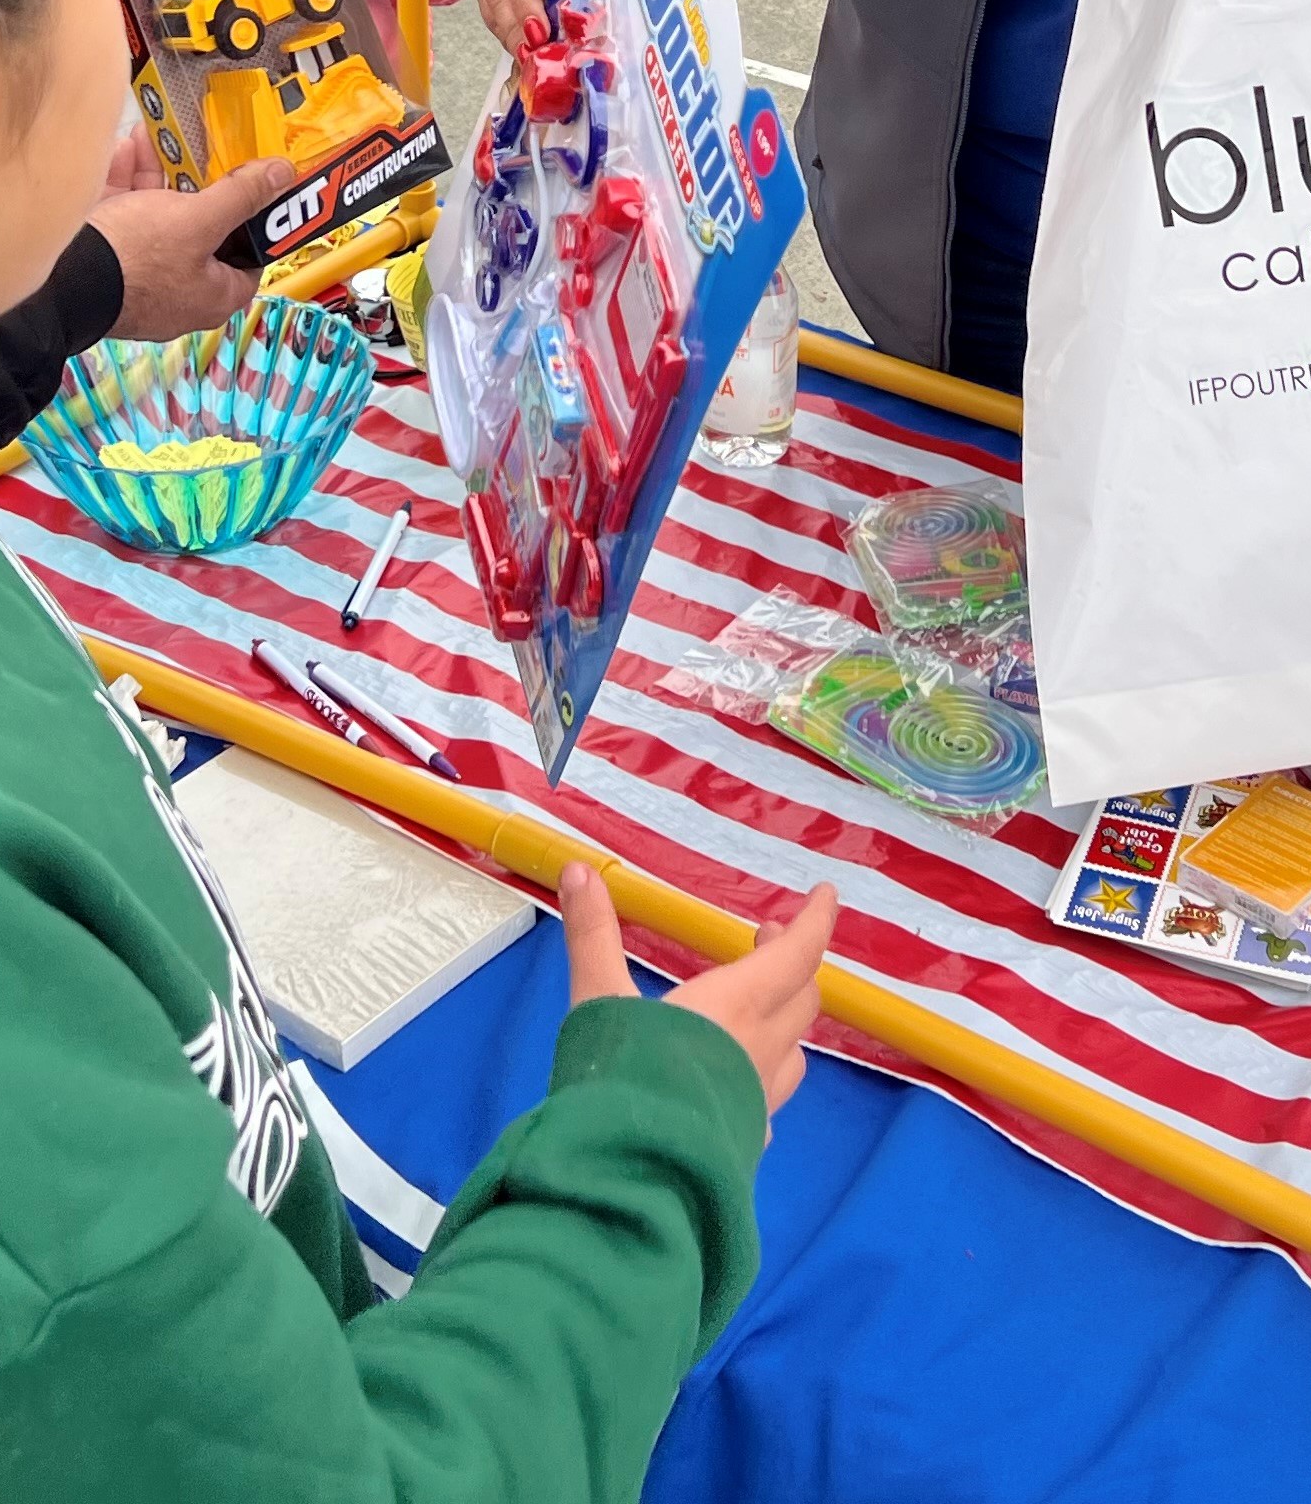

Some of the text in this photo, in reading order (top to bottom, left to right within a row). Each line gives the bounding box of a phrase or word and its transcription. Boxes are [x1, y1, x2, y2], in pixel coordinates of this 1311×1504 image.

[647, 65, 689, 178] PLAY SET
[342, 125, 437, 207] CONSTRUCTION
[347, 141, 384, 174] SERIES
[1111, 800, 1136, 814] Job!
[1136, 805, 1177, 823] Super
[1119, 833, 1163, 854] Great
[1124, 826, 1159, 842] Job!
[1072, 904, 1141, 931] Super Job!
